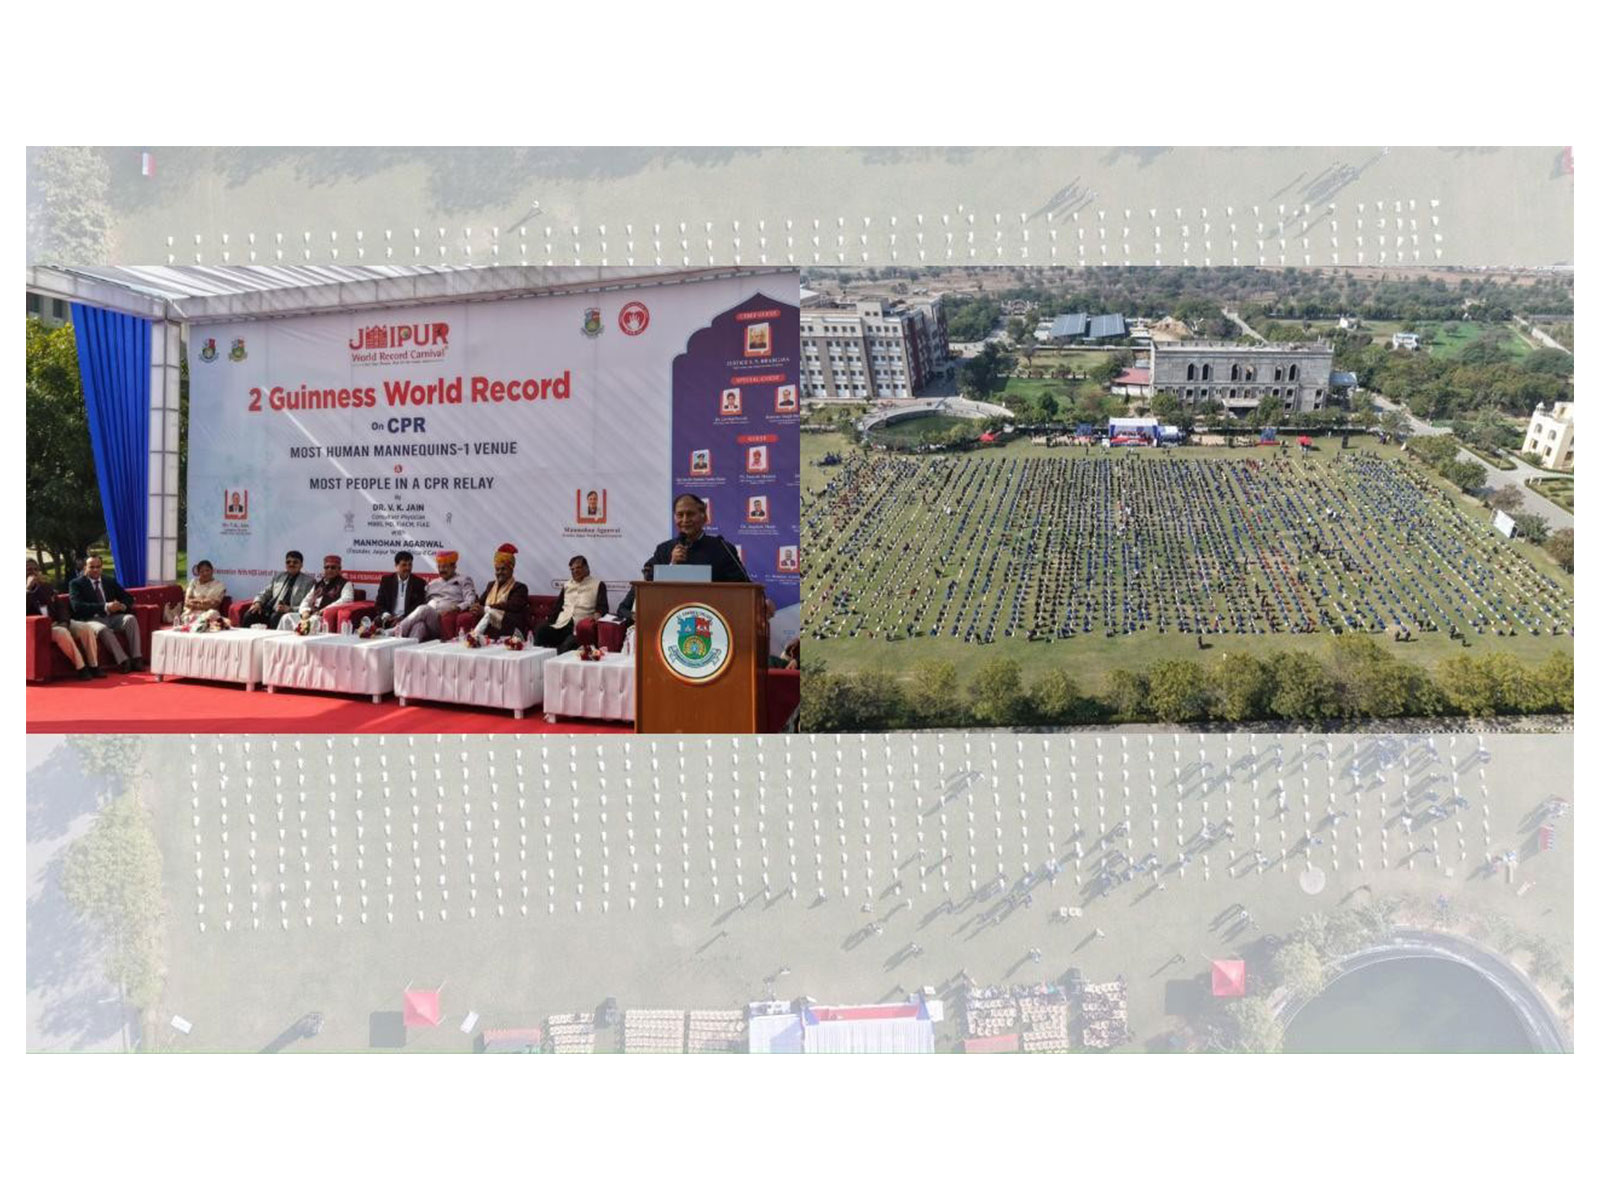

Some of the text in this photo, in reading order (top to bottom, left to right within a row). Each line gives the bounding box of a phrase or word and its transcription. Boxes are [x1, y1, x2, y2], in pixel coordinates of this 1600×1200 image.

[352, 349, 445, 362] World Record Carnival
[249, 370, 570, 411] 2 Guinness World Record
[371, 417, 426, 433] On CPR
[290, 441, 518, 458] MOST HUMAN MANNEQUINS-1 VENUE
[309, 477, 494, 490] MOST PEOPLE IN A CPR RELAY
